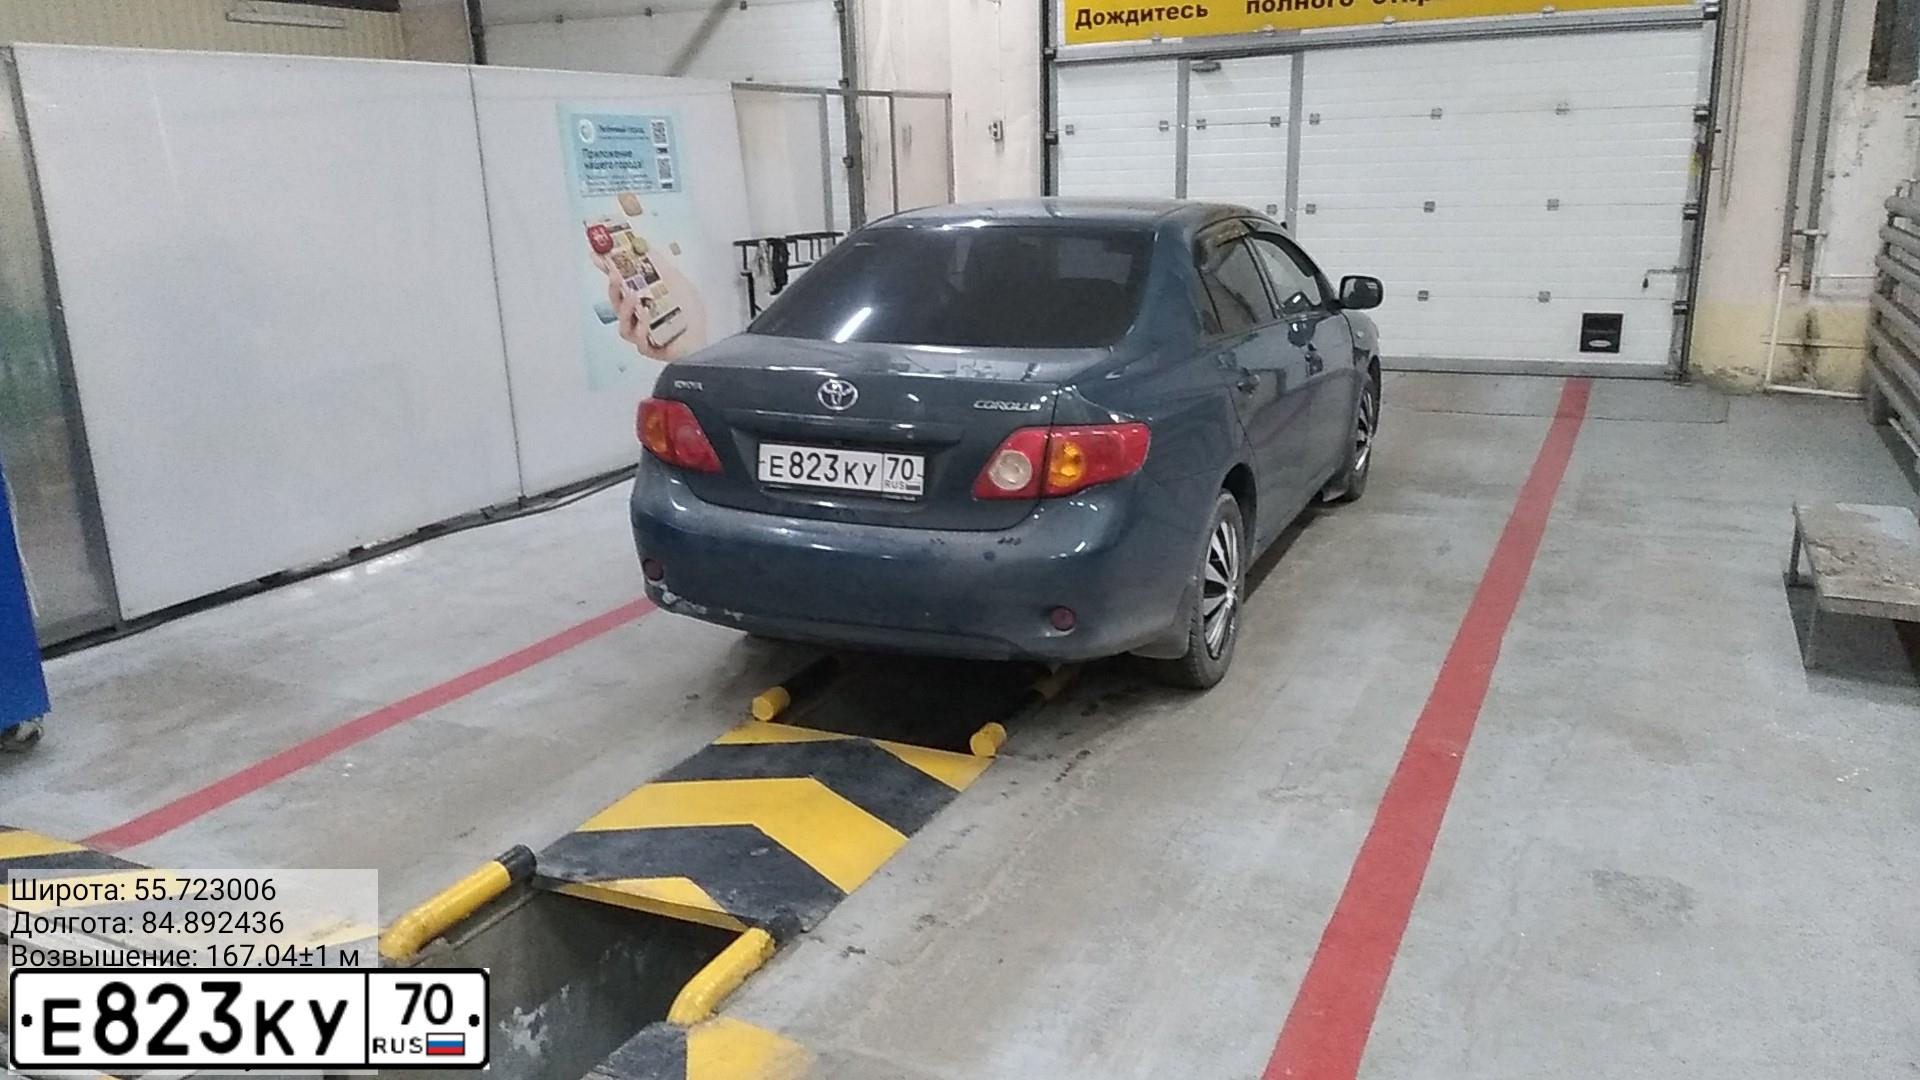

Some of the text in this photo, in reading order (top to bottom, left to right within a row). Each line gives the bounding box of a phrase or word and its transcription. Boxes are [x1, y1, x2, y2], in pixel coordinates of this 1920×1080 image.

[1075, 5, 1208, 30] Дождитесь
[769, 451, 914, 486] Е823КУ 70
[884, 480, 905, 490] RUS
